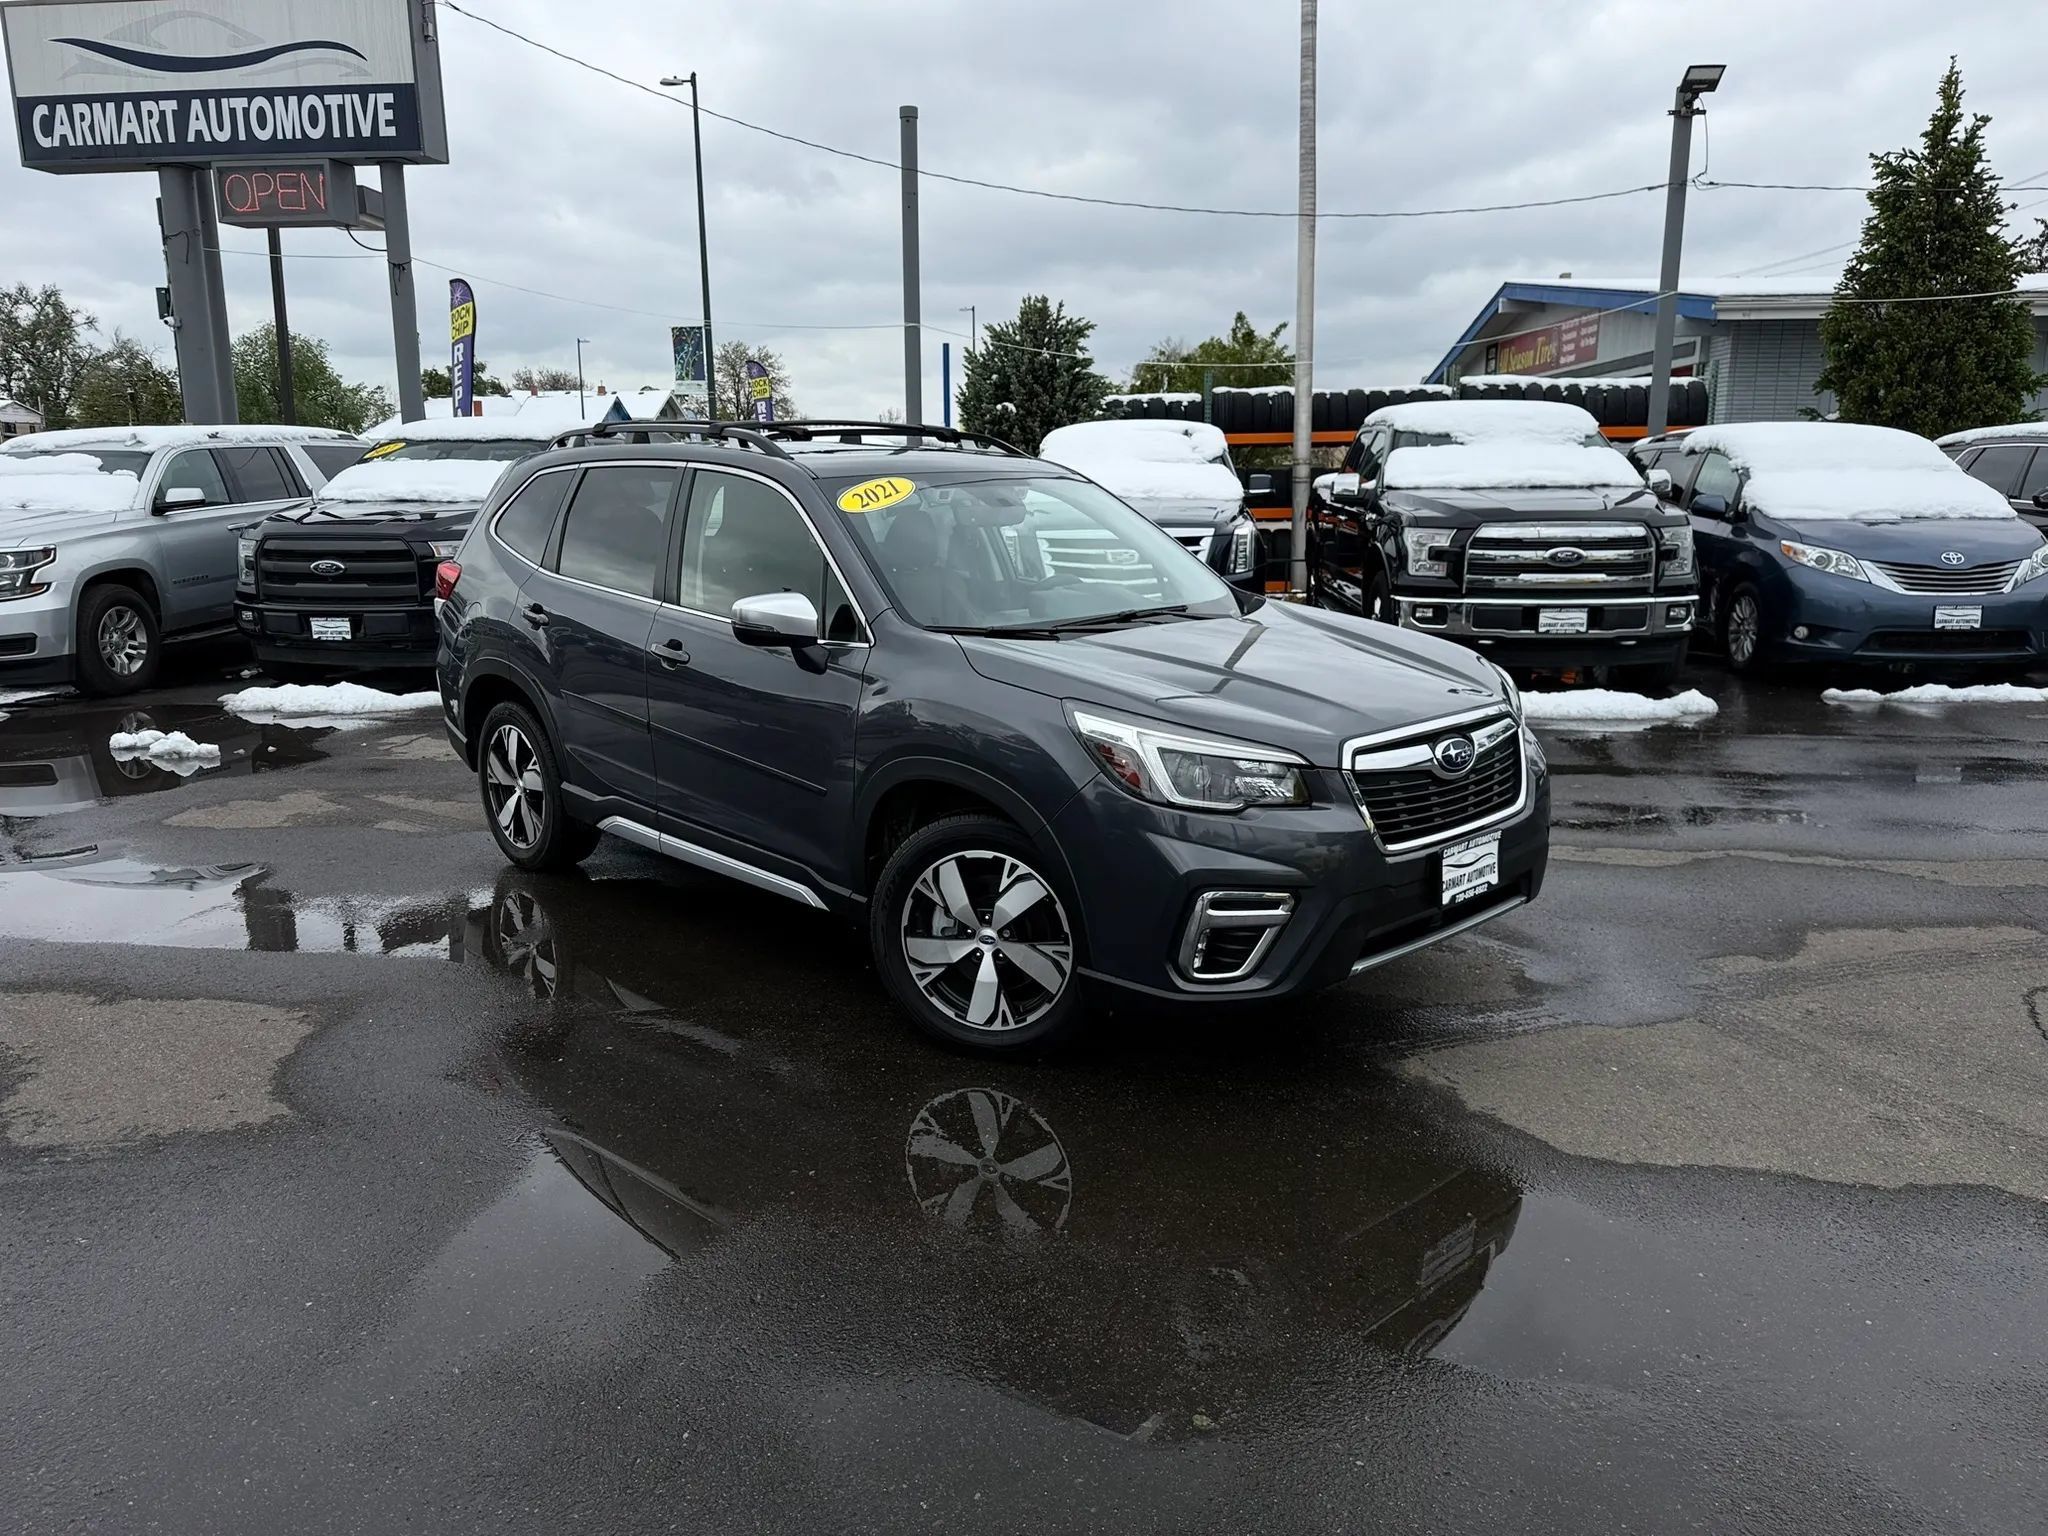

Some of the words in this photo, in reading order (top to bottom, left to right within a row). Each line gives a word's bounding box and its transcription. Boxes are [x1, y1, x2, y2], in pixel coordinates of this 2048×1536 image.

[32, 99, 179, 149] CARMART
[186, 92, 397, 143] AUTOMOTIVE
[225, 171, 326, 212] OPEN
[452, 320, 470, 340] CHIP
[852, 480, 901, 508] 2021
[1443, 841, 1469, 858] CARMART
[1467, 830, 1502, 849] AUTOMOTIVE
[1442, 873, 1467, 892] CARMART
[1466, 861, 1496, 884] AUTOMOTIVE
